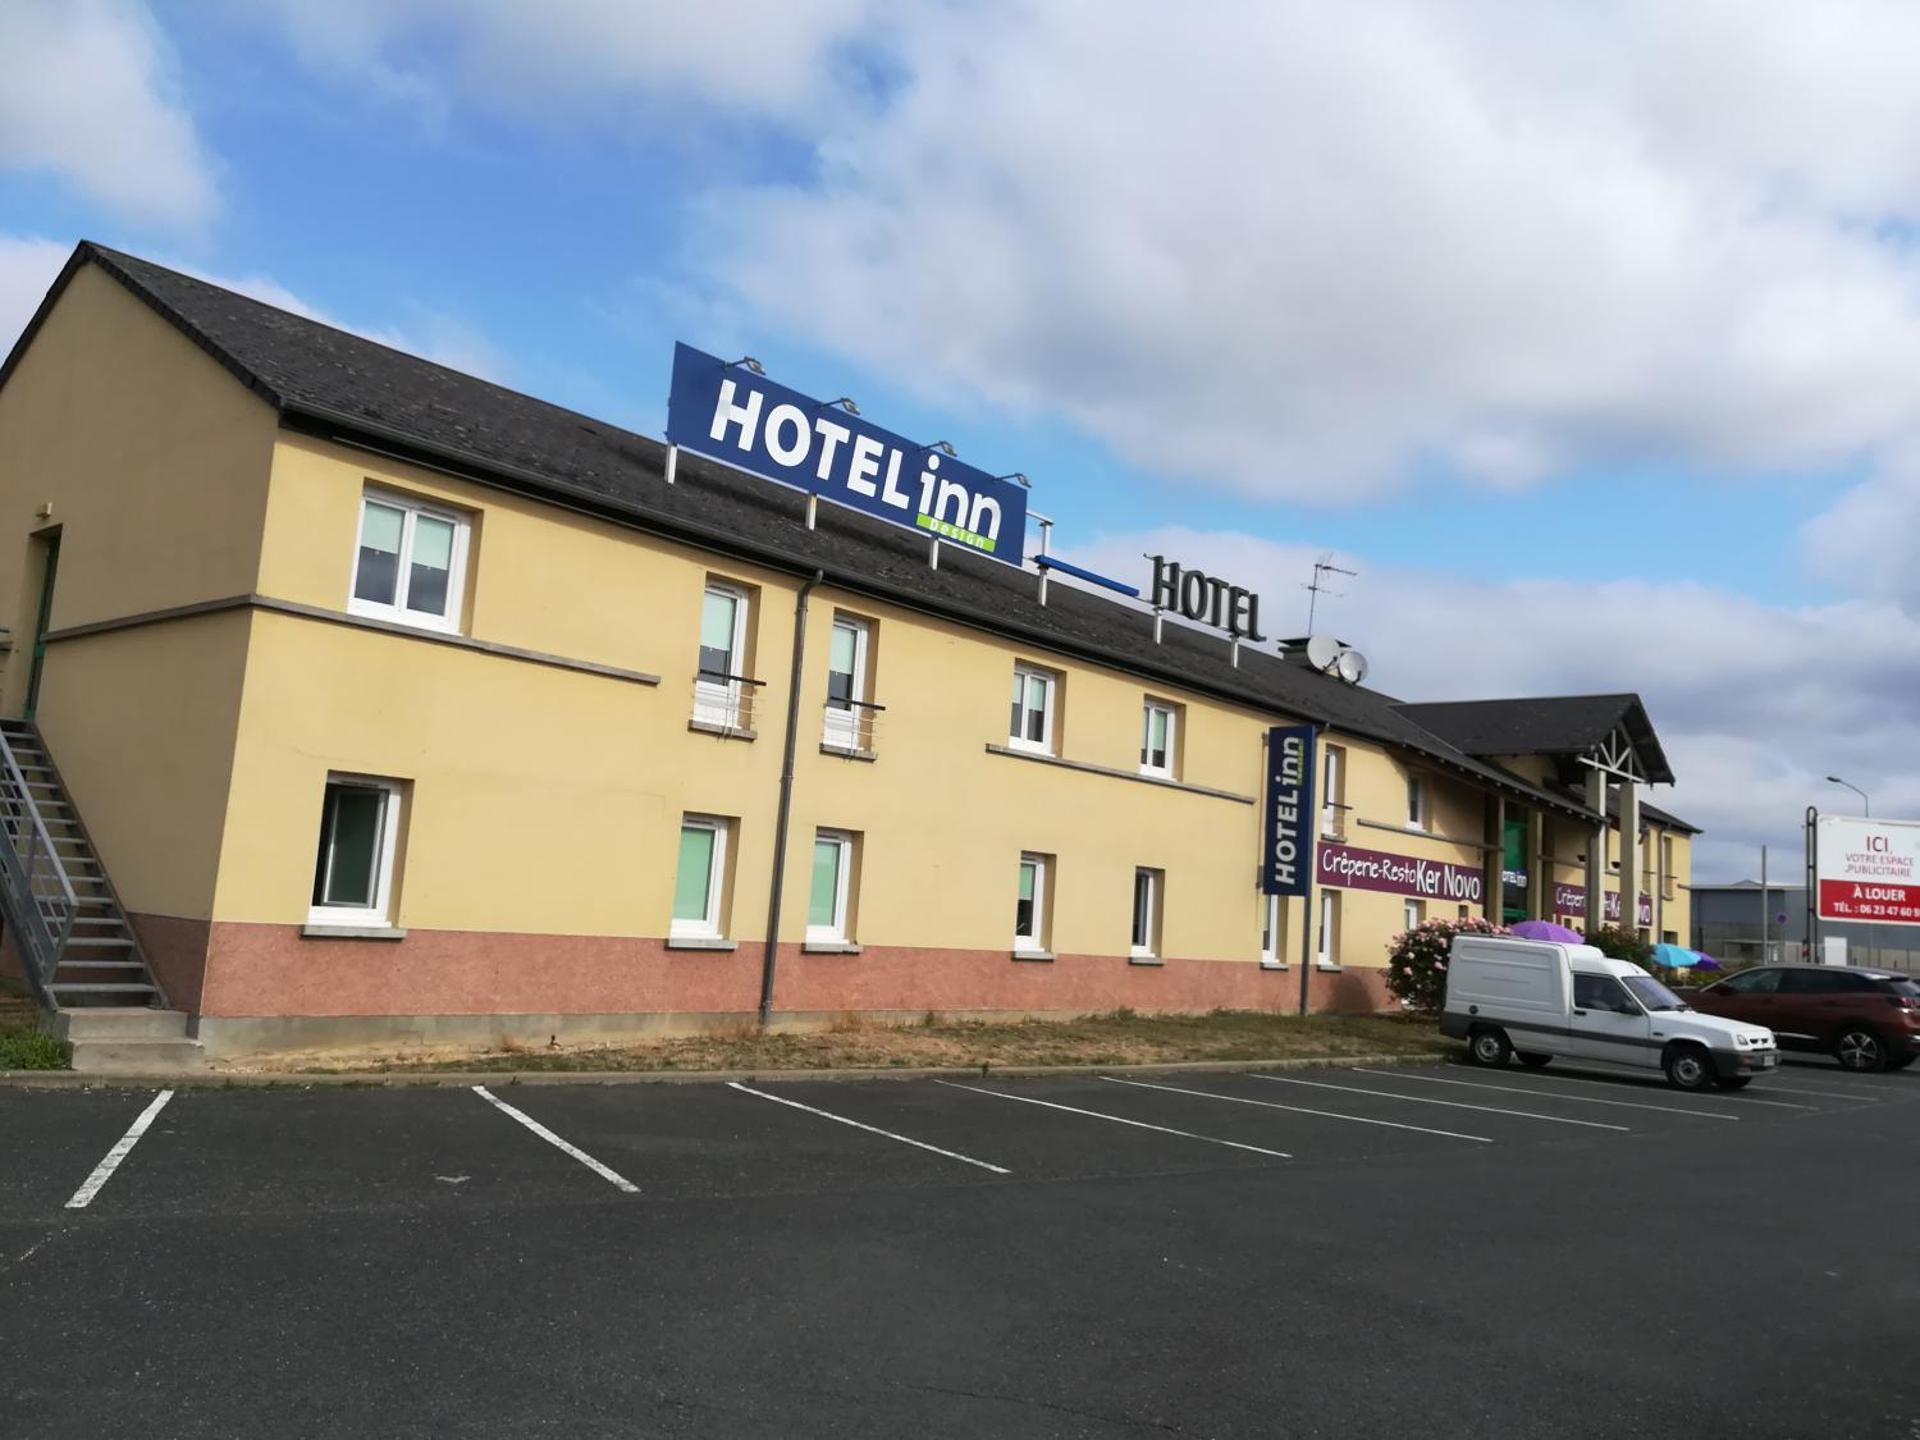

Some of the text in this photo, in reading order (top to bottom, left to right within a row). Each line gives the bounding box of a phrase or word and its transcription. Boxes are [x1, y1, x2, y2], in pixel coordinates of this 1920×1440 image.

[710, 378, 1001, 540] HOTEL inn
[1152, 555, 1266, 641] HOTEL
[1275, 736, 1299, 885] HOTEL inn
[1416, 860, 1441, 895] Ker
[1444, 864, 1481, 900] Novo
[1845, 854, 1914, 866] VOTRE ESPACE
[1865, 887, 1906, 902] LOUER
